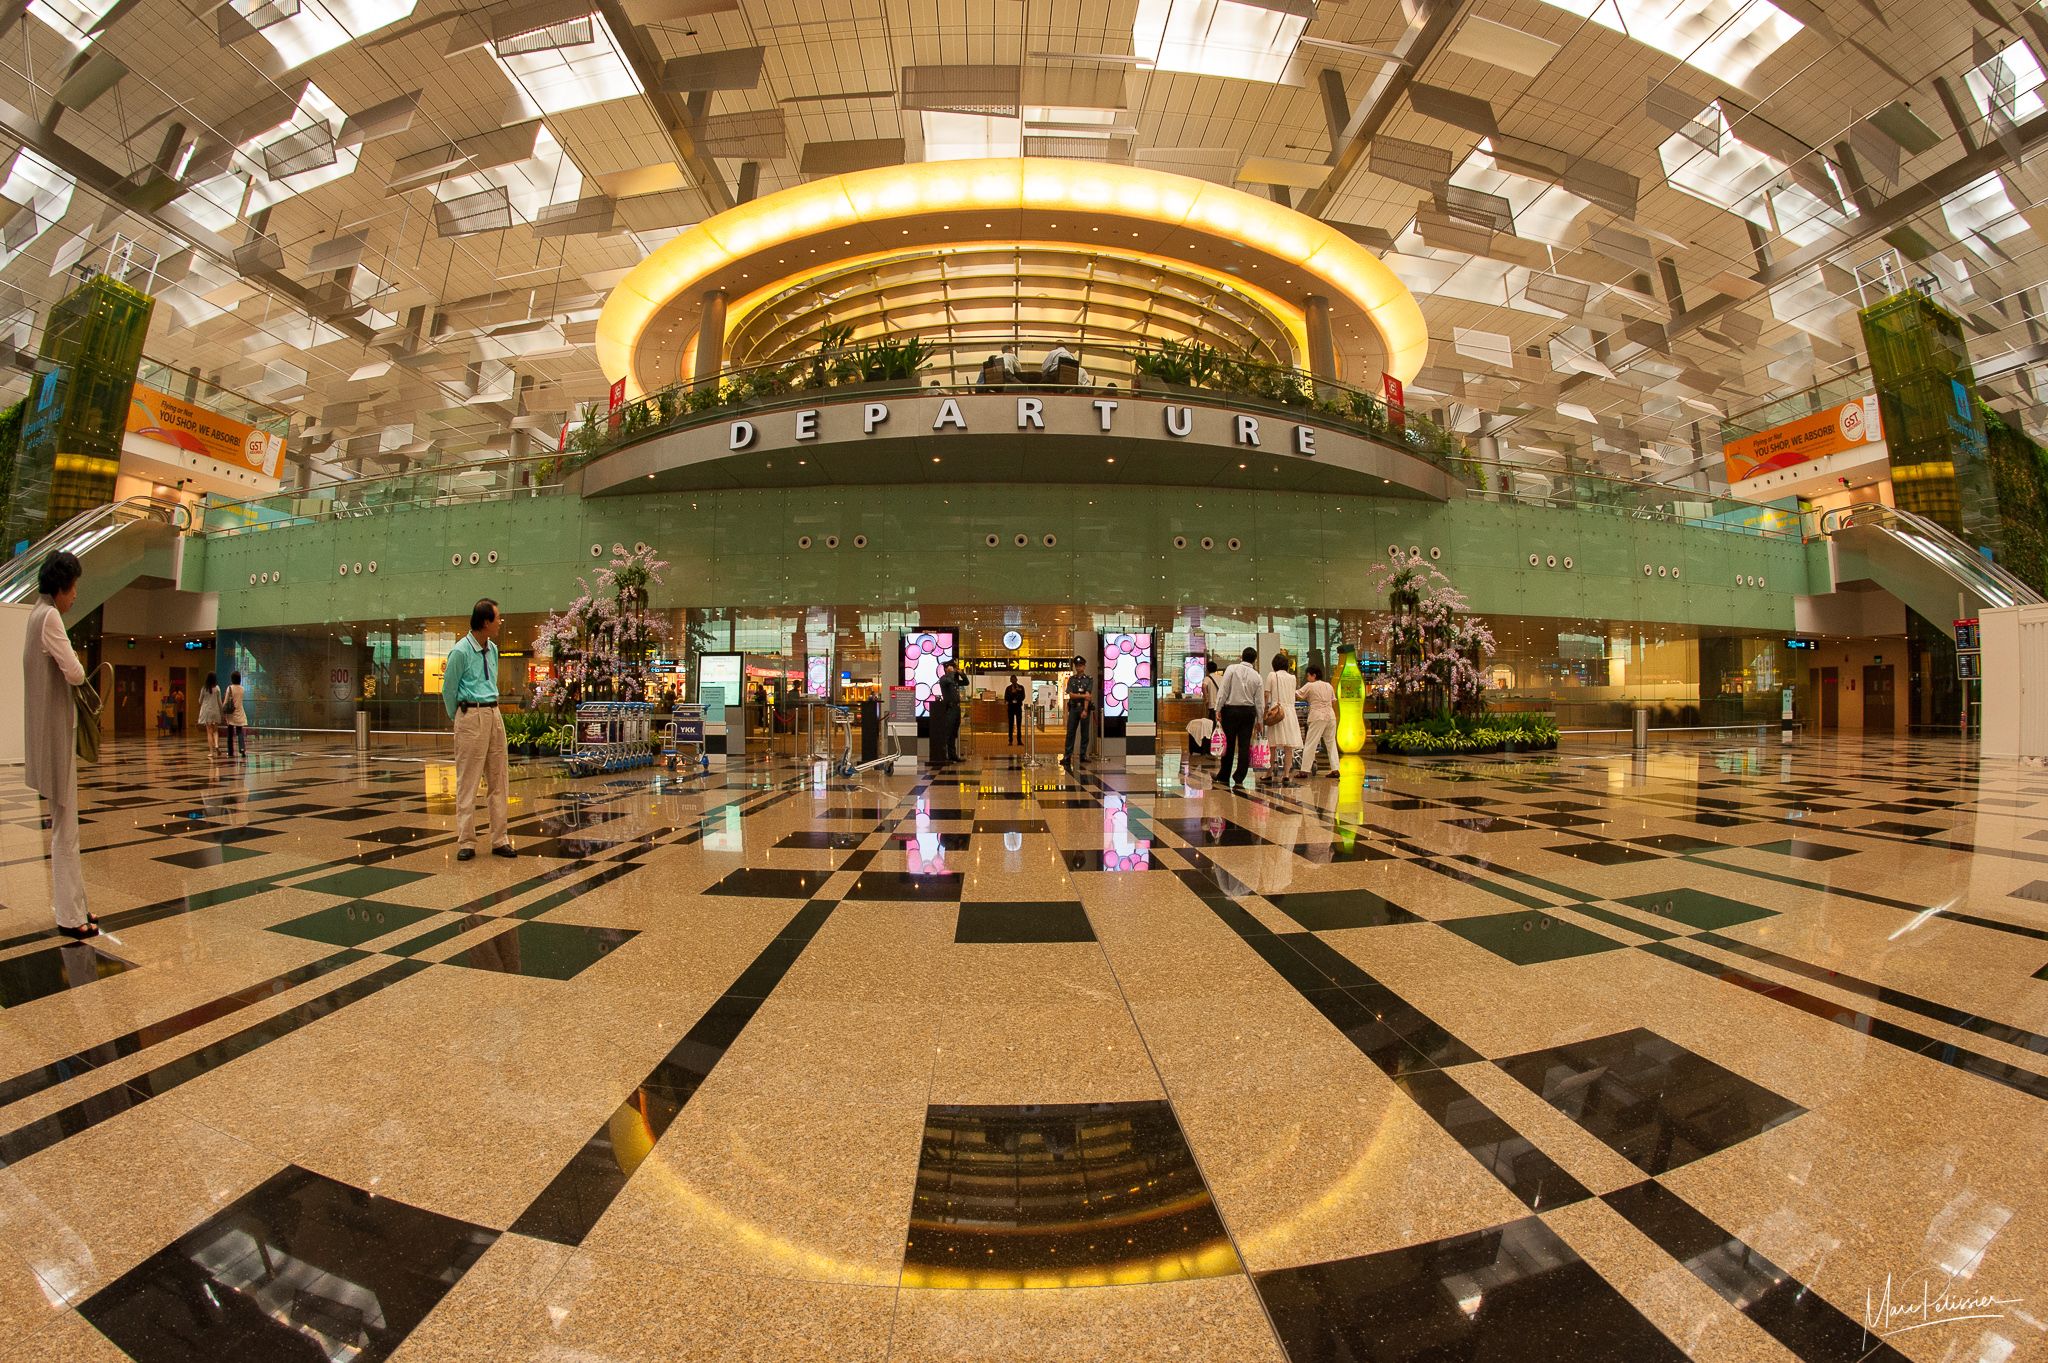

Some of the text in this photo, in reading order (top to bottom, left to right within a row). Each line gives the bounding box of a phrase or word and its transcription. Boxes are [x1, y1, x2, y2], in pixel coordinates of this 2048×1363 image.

[161, 400, 179, 414] Flying
[182, 408, 194, 418] Not
[159, 409, 175, 424] YOU
[176, 416, 198, 433] SHOP,
[199, 423, 210, 437] WE
[210, 427, 242, 447] ABSORB!
[728, 397, 1317, 455] DEPARTURE
[1843, 411, 1859, 428] GST
[249, 440, 263, 451] GST
[1753, 436, 1769, 448] Flying
[1773, 432, 1783, 442] Not
[1754, 444, 1770, 458] YOU
[1770, 439, 1791, 454] SHOP,
[1791, 434, 1803, 446] WE
[1803, 424, 1836, 443] ABSORB!
